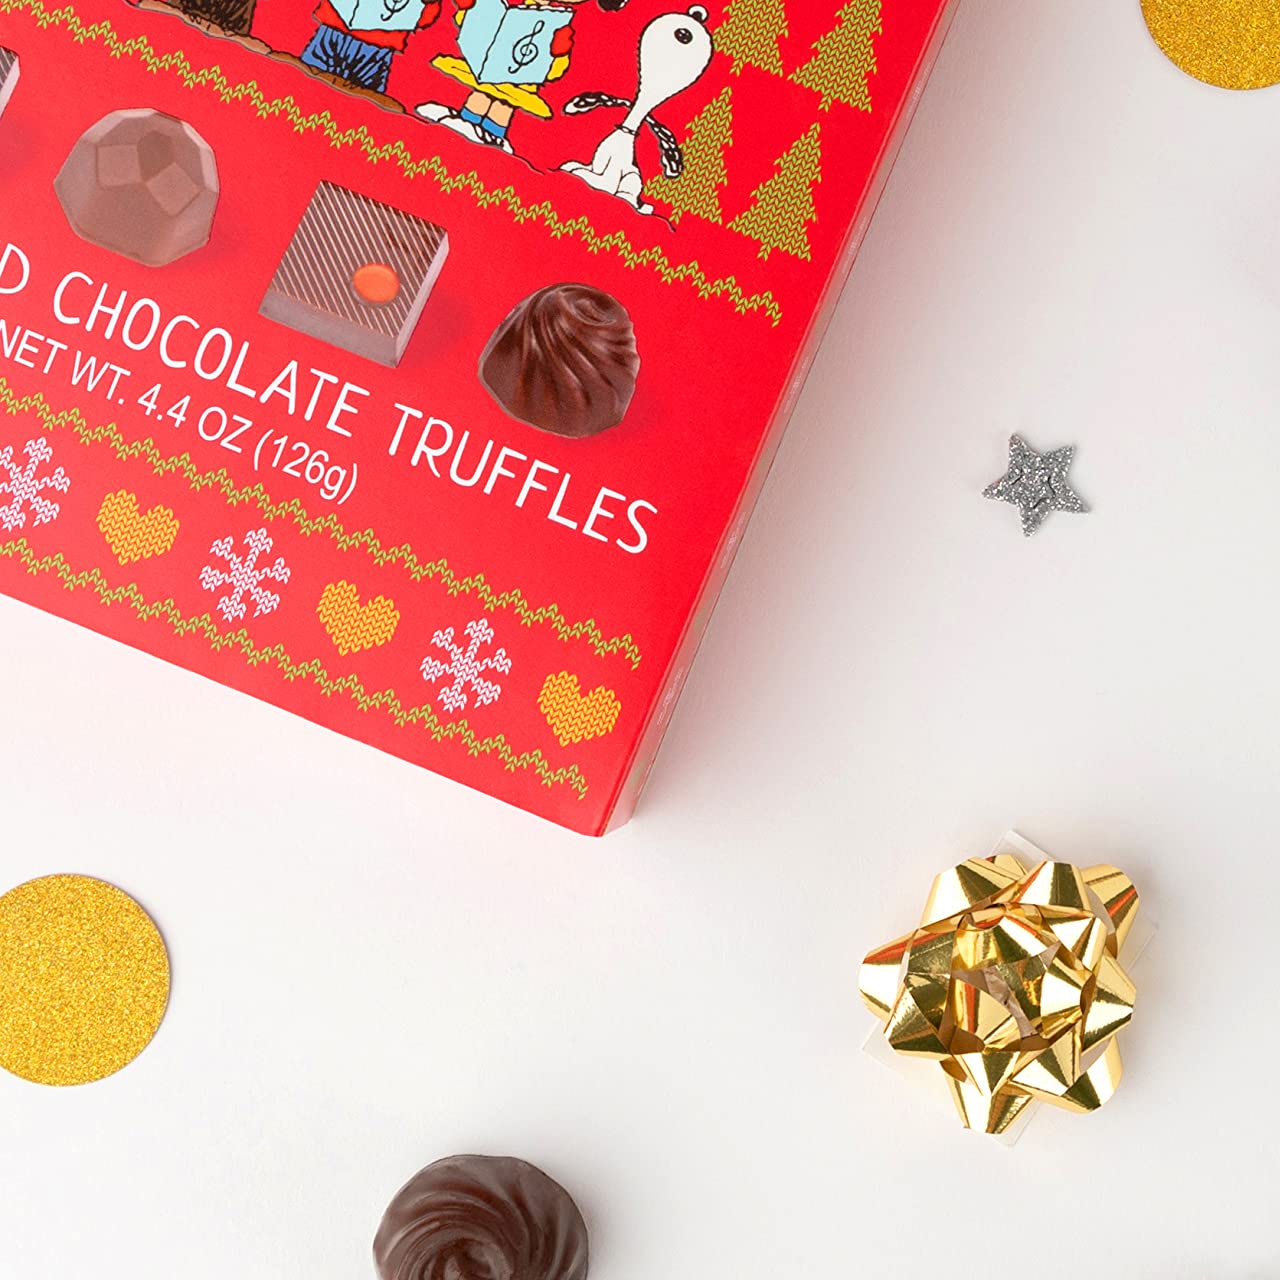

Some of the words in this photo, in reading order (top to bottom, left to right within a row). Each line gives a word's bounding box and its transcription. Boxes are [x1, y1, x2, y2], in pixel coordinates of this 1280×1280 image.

[0, 318, 68, 375] NET
[71, 350, 132, 405] WT.
[137, 383, 191, 428] 4.4
[198, 406, 253, 454] OZ
[253, 428, 358, 505] (126g)
[53, 271, 370, 438] CHOCOLATE
[388, 402, 658, 554] TRUFFLES
